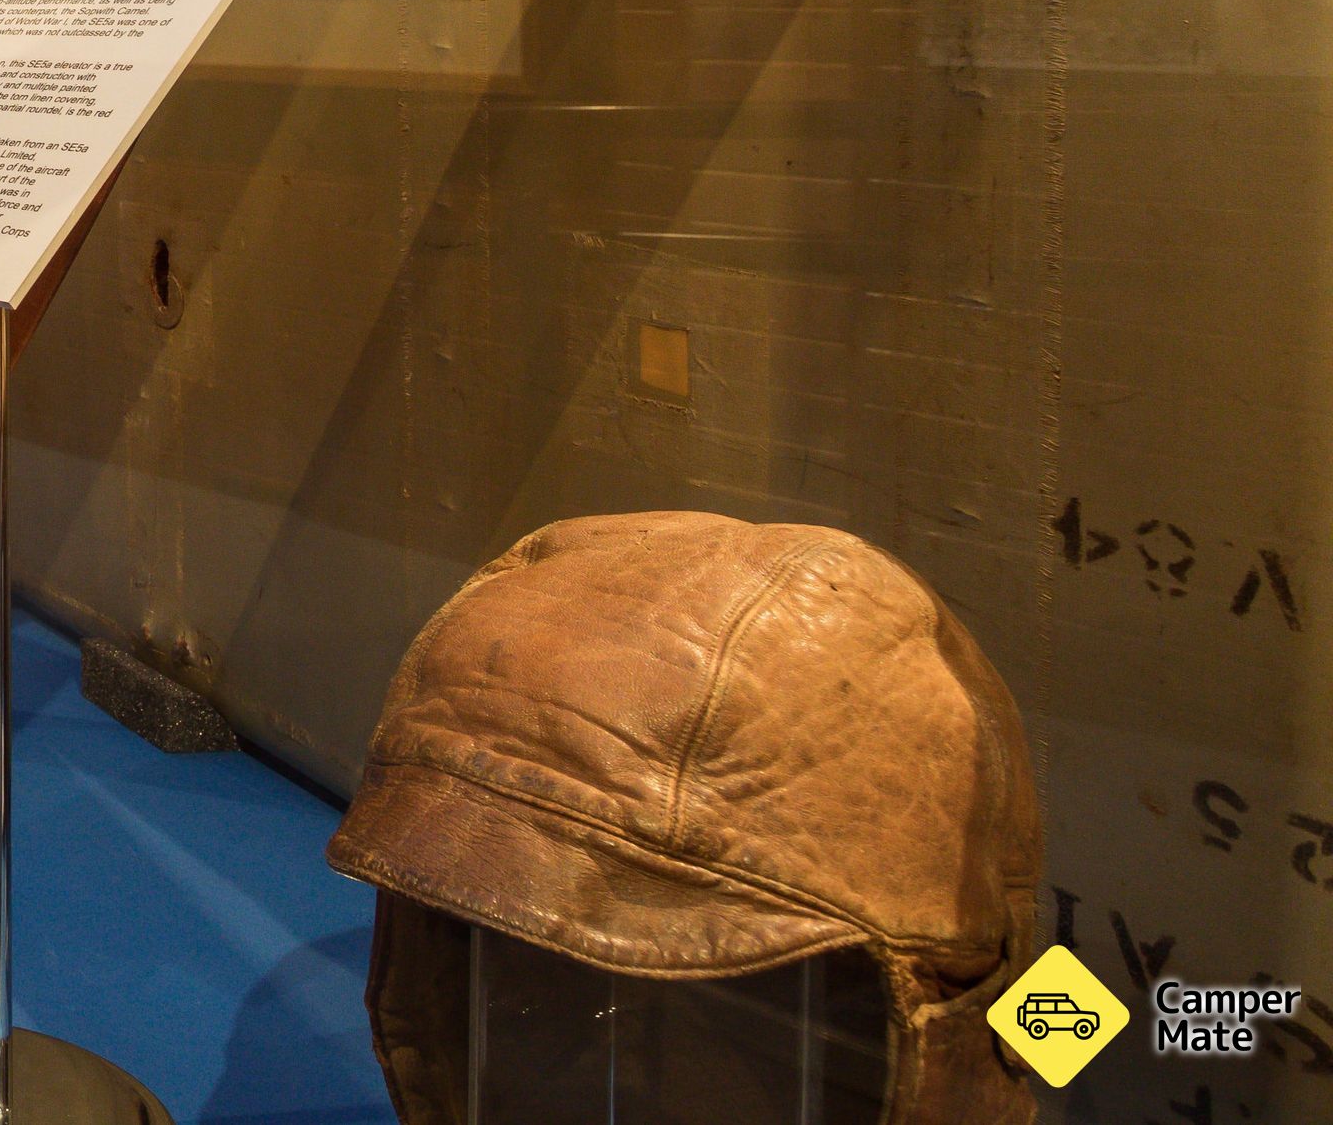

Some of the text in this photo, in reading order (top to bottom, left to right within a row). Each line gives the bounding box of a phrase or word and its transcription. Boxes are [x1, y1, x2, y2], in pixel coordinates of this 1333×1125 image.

[22, 139, 45, 149] from
[61, 142, 89, 153] SE5a
[0, 150, 37, 161] Limited,
[17, 164, 34, 173] the
[34, 166, 70, 176] aircraft
[19, 177, 36, 186] the
[0, 189, 19, 197] was
[21, 203, 43, 212] and
[1, 225, 30, 238] Corps
